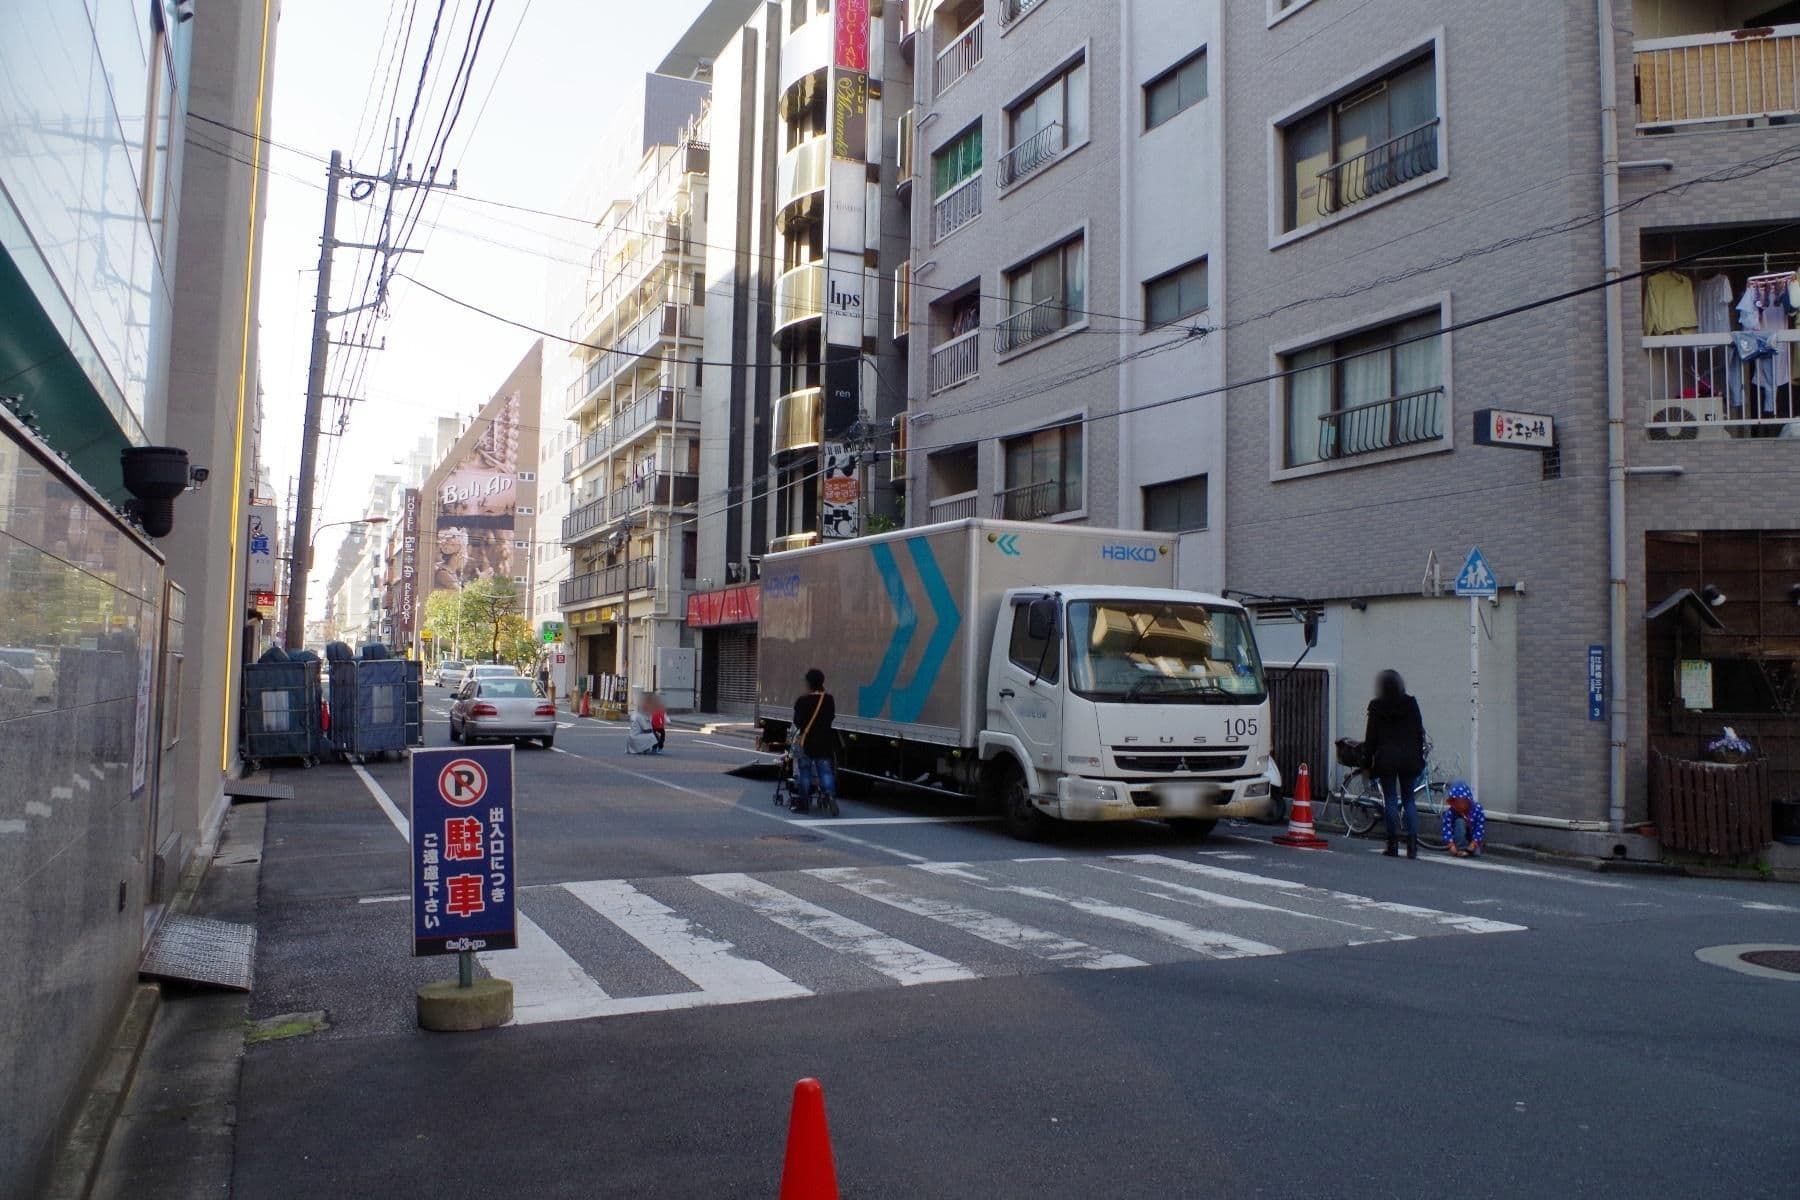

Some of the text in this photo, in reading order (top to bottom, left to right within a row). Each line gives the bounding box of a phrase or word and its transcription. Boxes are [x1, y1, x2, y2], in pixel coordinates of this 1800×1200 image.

[407, 495, 416, 532] HOTEL
[402, 582, 412, 625] RESORT
[1224, 718, 1257, 736] 105
[1593, 707, 1601, 717] 3
[1124, 735, 1239, 744] FUSO
[444, 815, 485, 917] 駐車
[489, 807, 505, 903] 出入口につき
[423, 832, 440, 929] ご遠慮下さい
